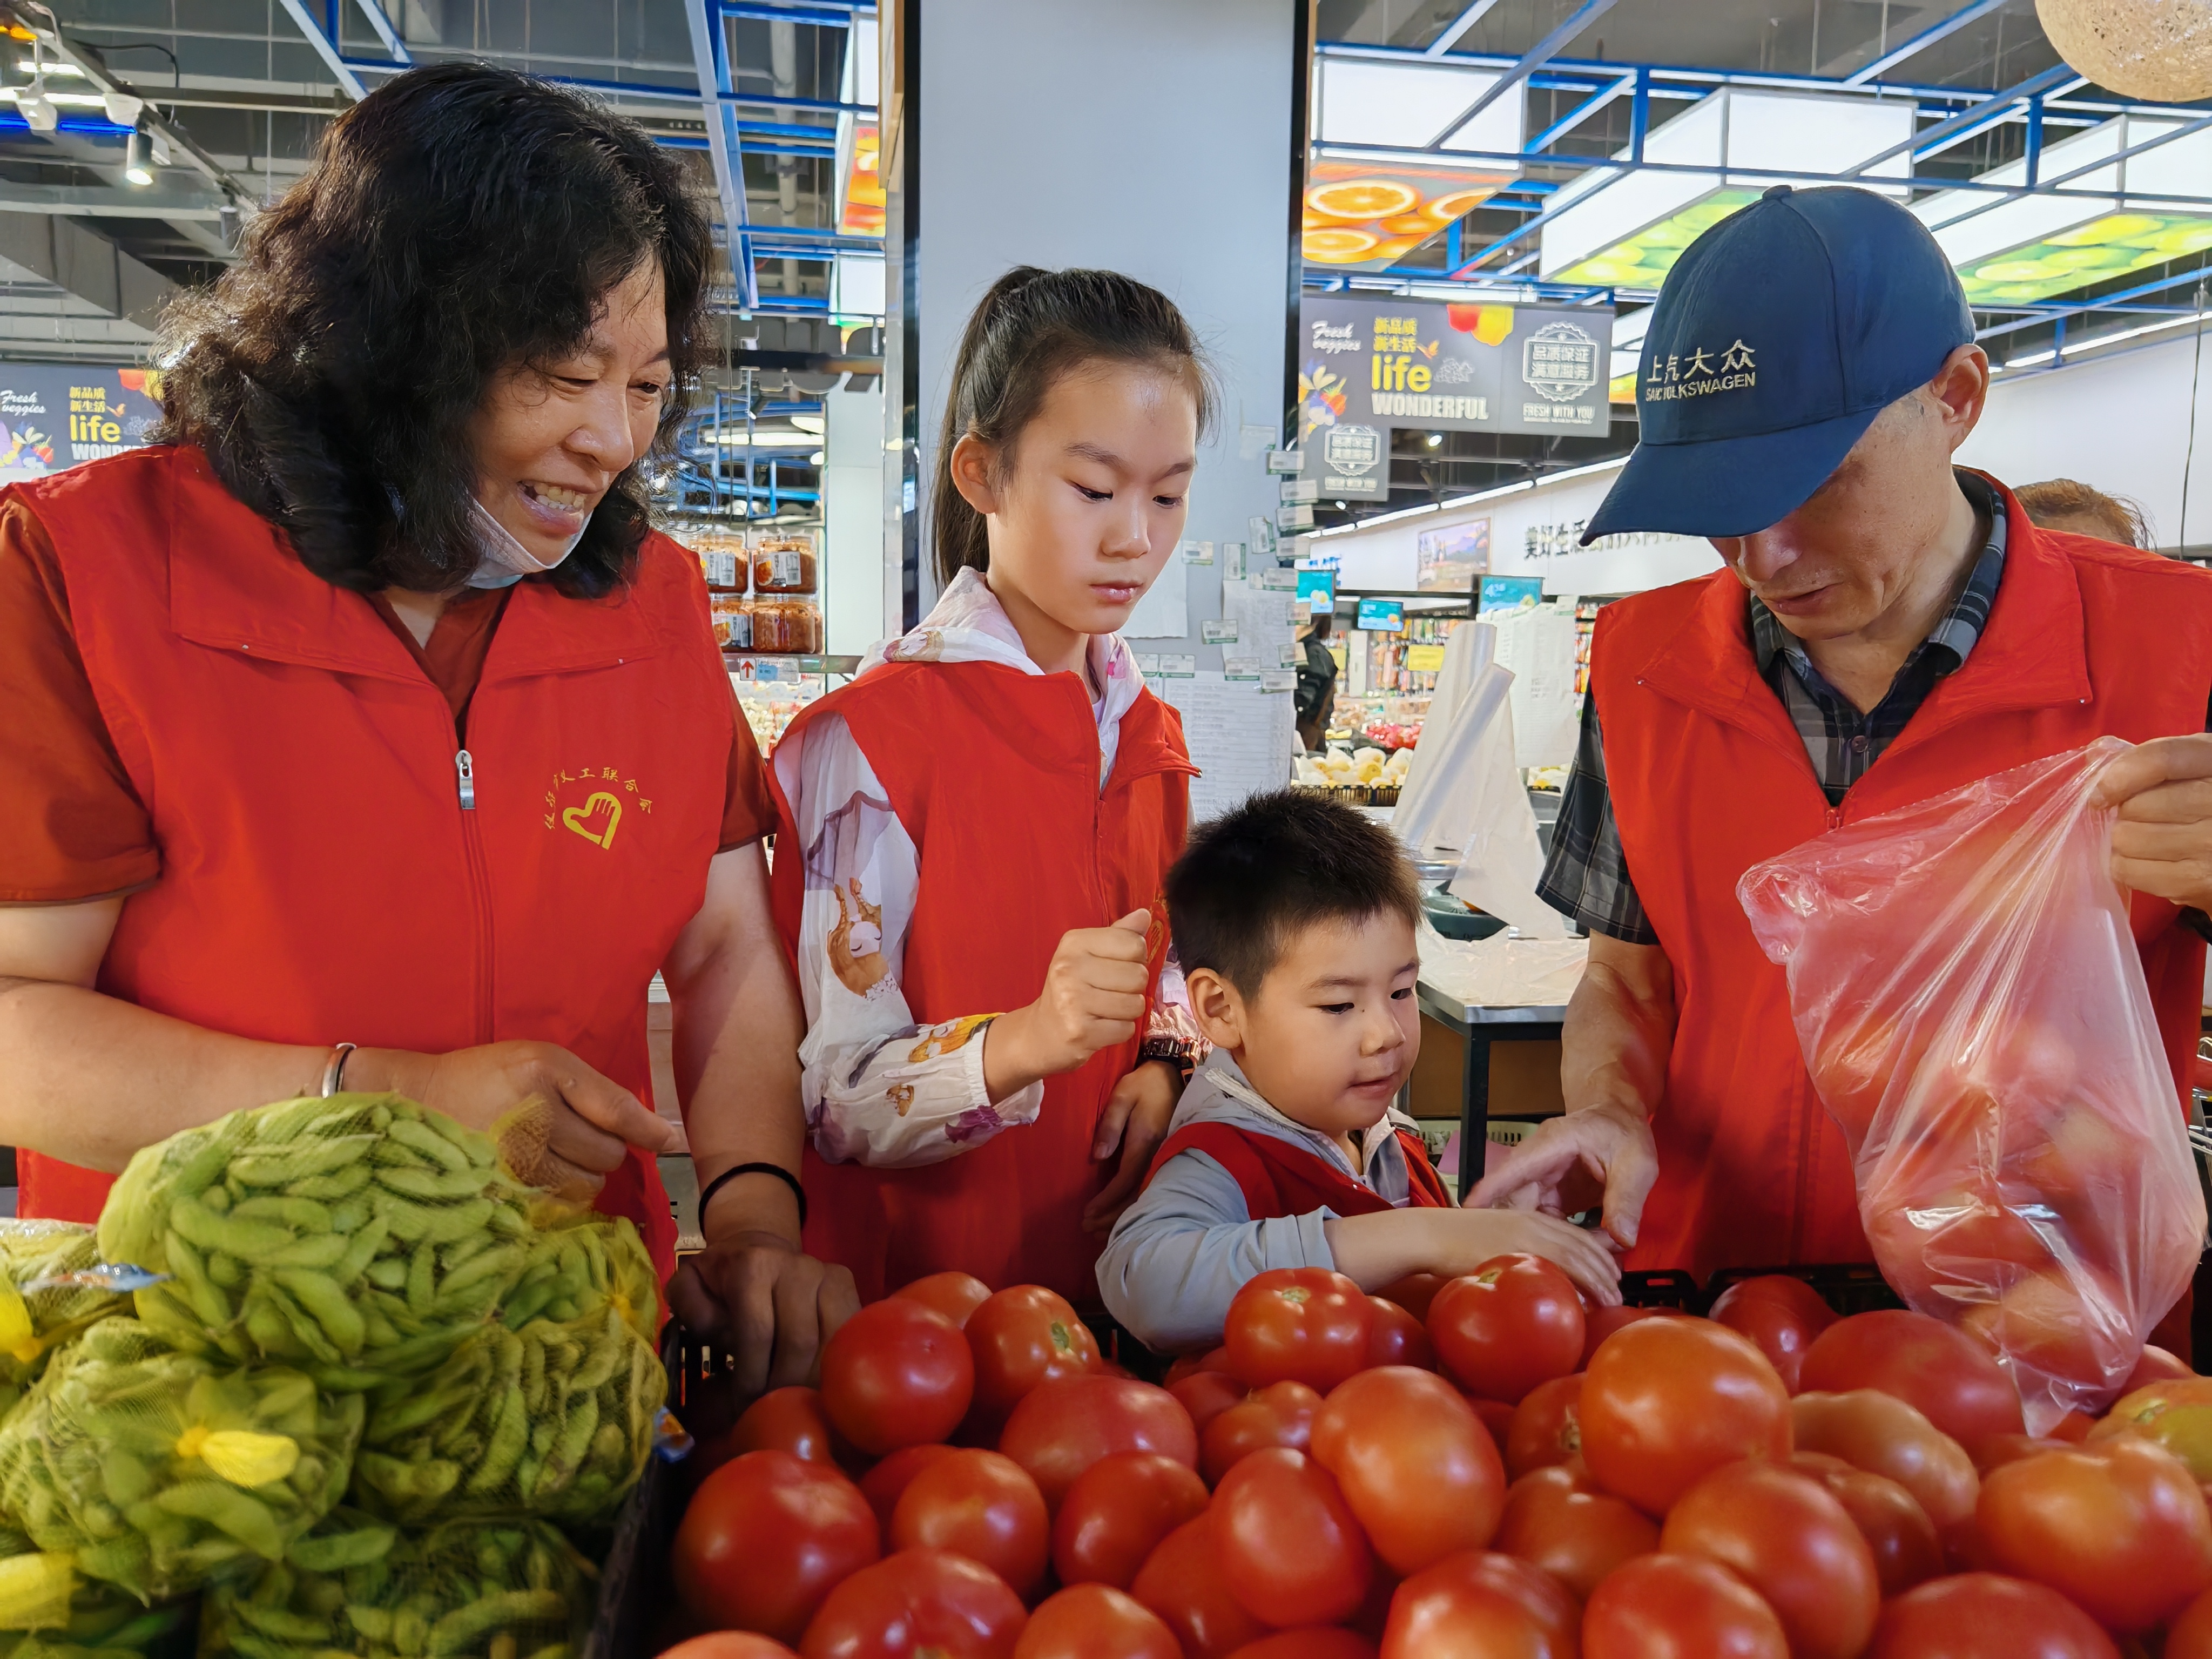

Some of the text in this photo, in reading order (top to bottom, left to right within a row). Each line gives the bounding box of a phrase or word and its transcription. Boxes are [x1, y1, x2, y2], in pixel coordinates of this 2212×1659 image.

[1372, 354, 1432, 392] life
[1647, 339, 1756, 383] 上汽大众
[0, 389, 38, 404] Fresh
[1372, 392, 1489, 420] WONDERFUL
[1523, 403, 1595, 420] FRESH WITH YOU
[70, 414, 120, 442] life
